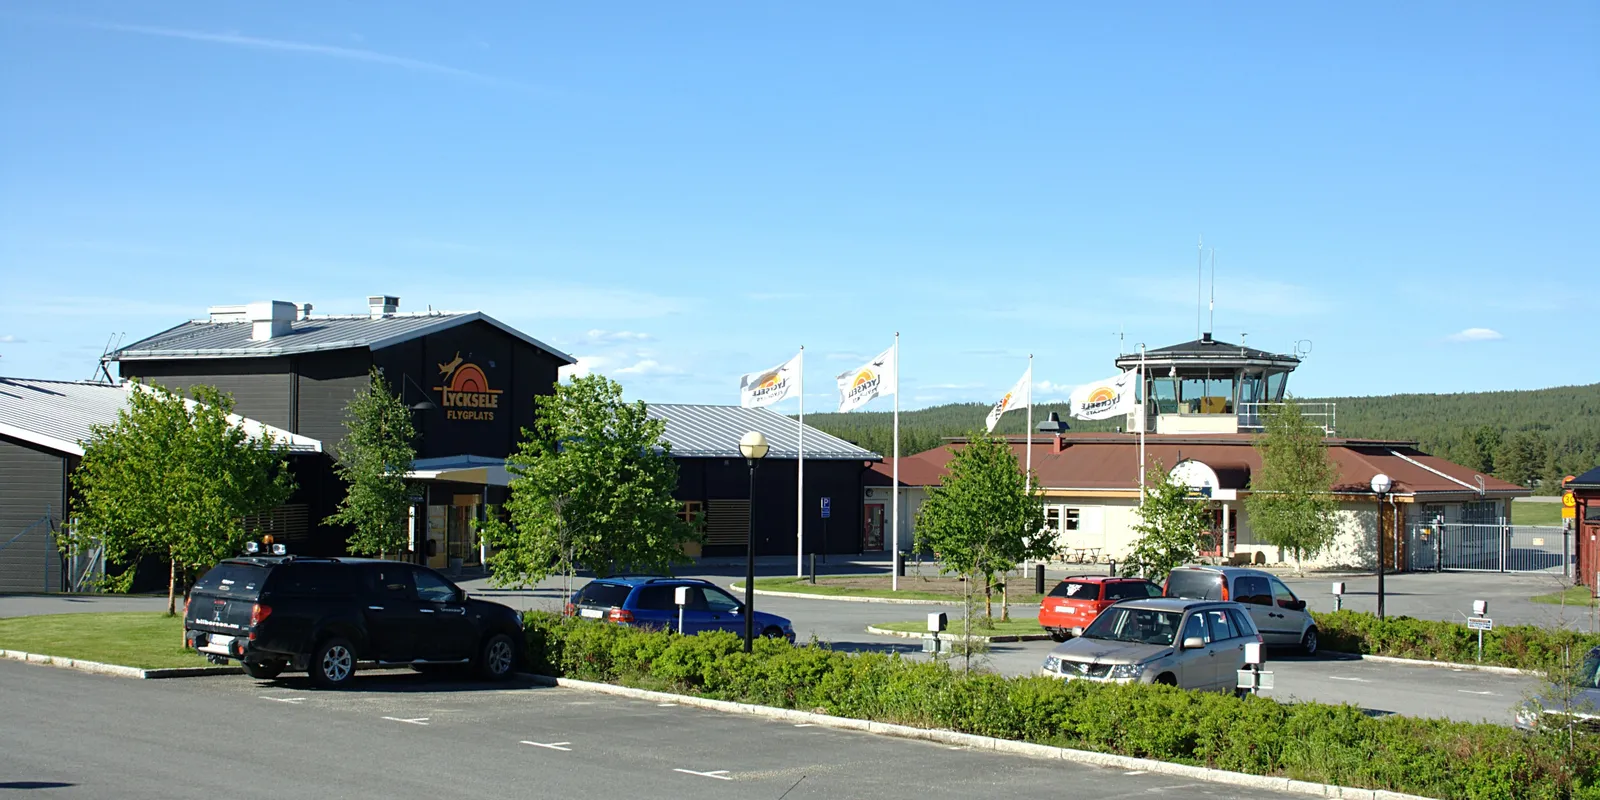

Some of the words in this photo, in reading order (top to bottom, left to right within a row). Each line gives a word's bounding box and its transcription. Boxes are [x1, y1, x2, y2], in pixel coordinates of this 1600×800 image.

[443, 386, 498, 408] LYCKSELE
[447, 410, 494, 420] FLYGPLATS
[824, 498, 829, 507] P
